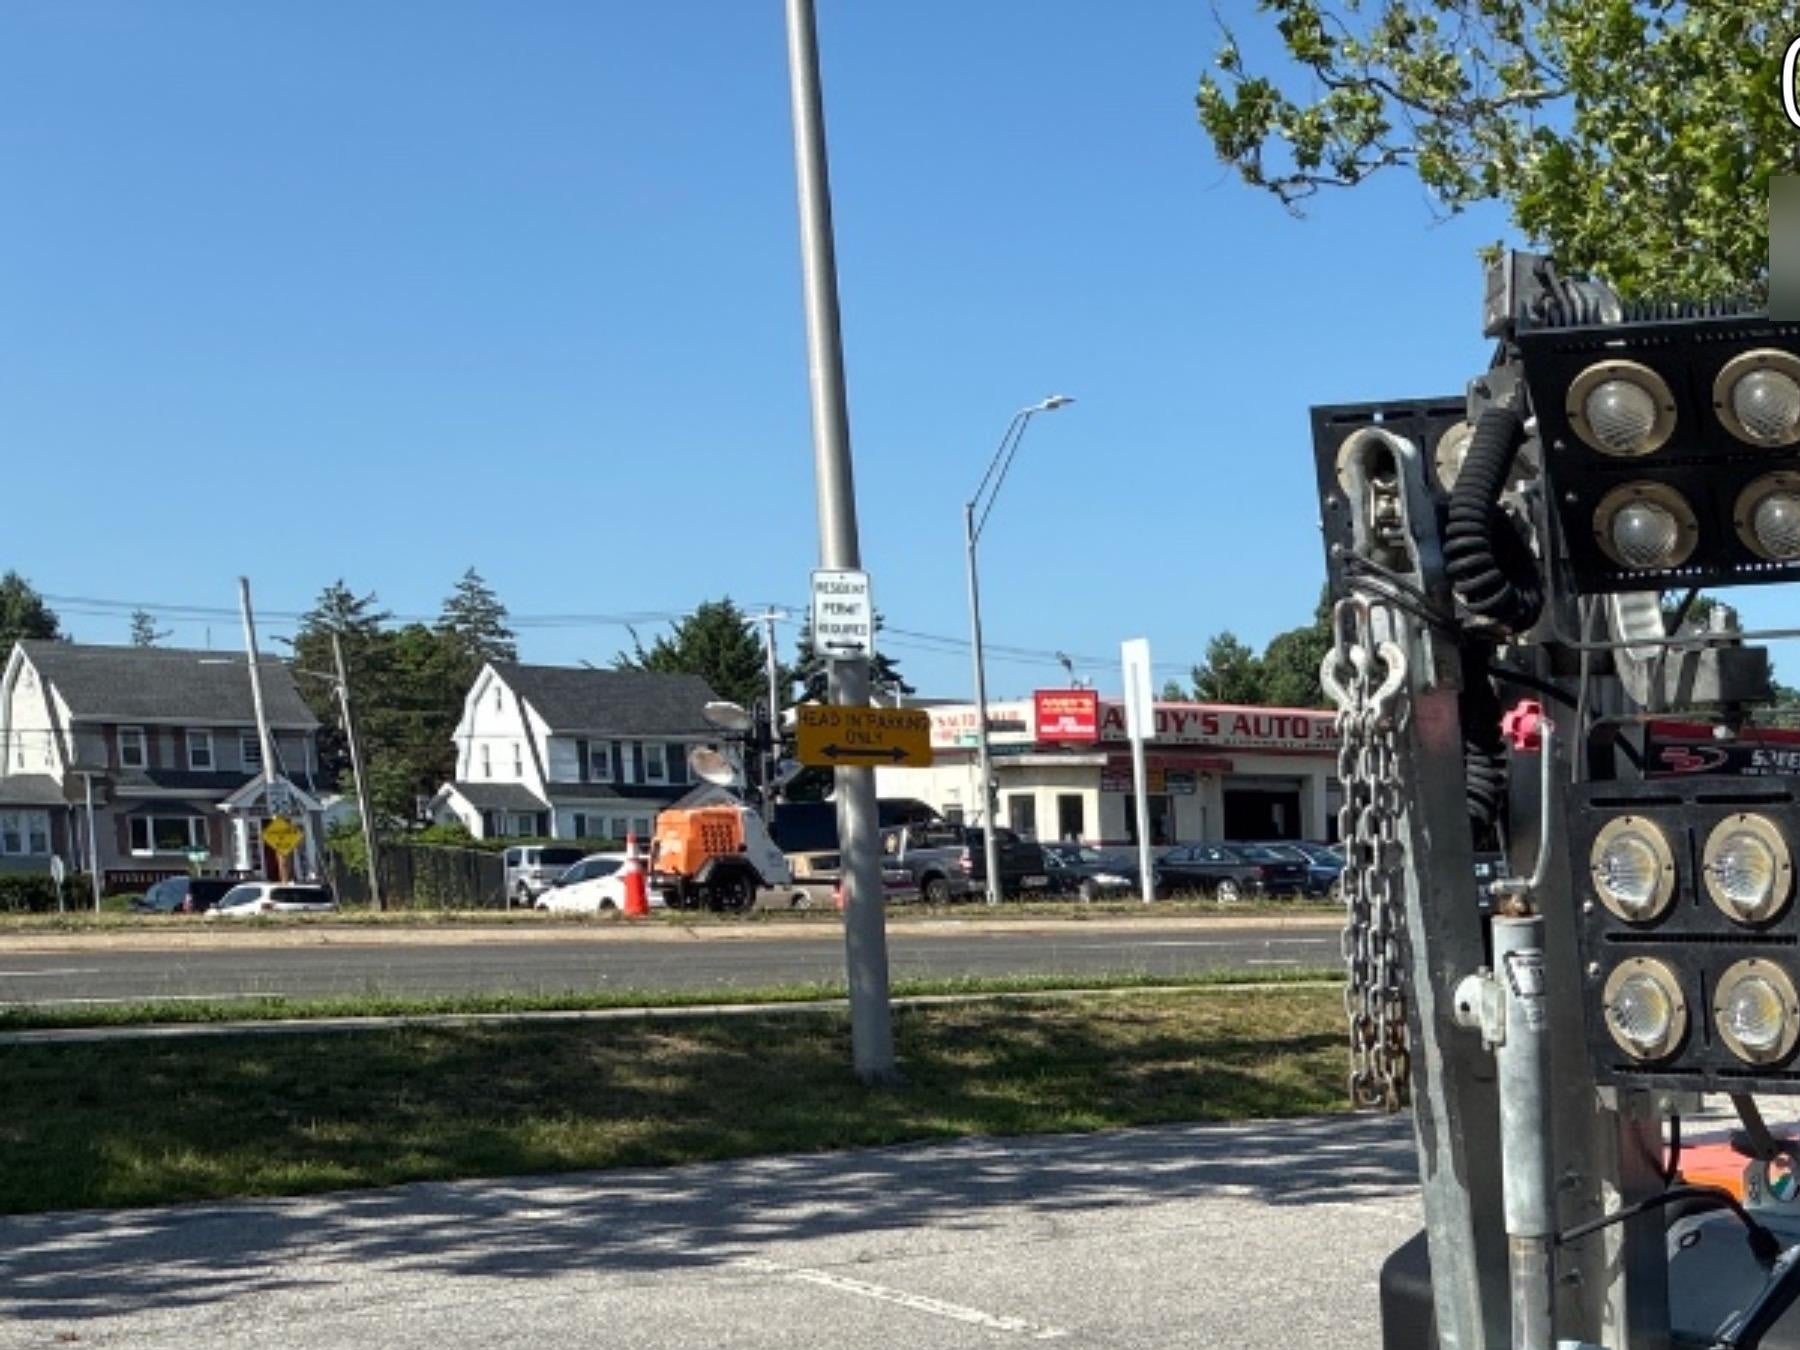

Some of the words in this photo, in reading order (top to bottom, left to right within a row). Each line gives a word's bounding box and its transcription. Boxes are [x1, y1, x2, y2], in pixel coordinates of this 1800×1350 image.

[815, 581, 865, 595] RESIDENT
[822, 602, 862, 616] PERMIT
[799, 710, 841, 727] HEAD
[846, 712, 862, 727] IN
[865, 711, 930, 731] PARKING
[1102, 707, 1219, 736] ADY'S
[1231, 713, 1309, 738] AUTO
[845, 729, 883, 745] ONLY
